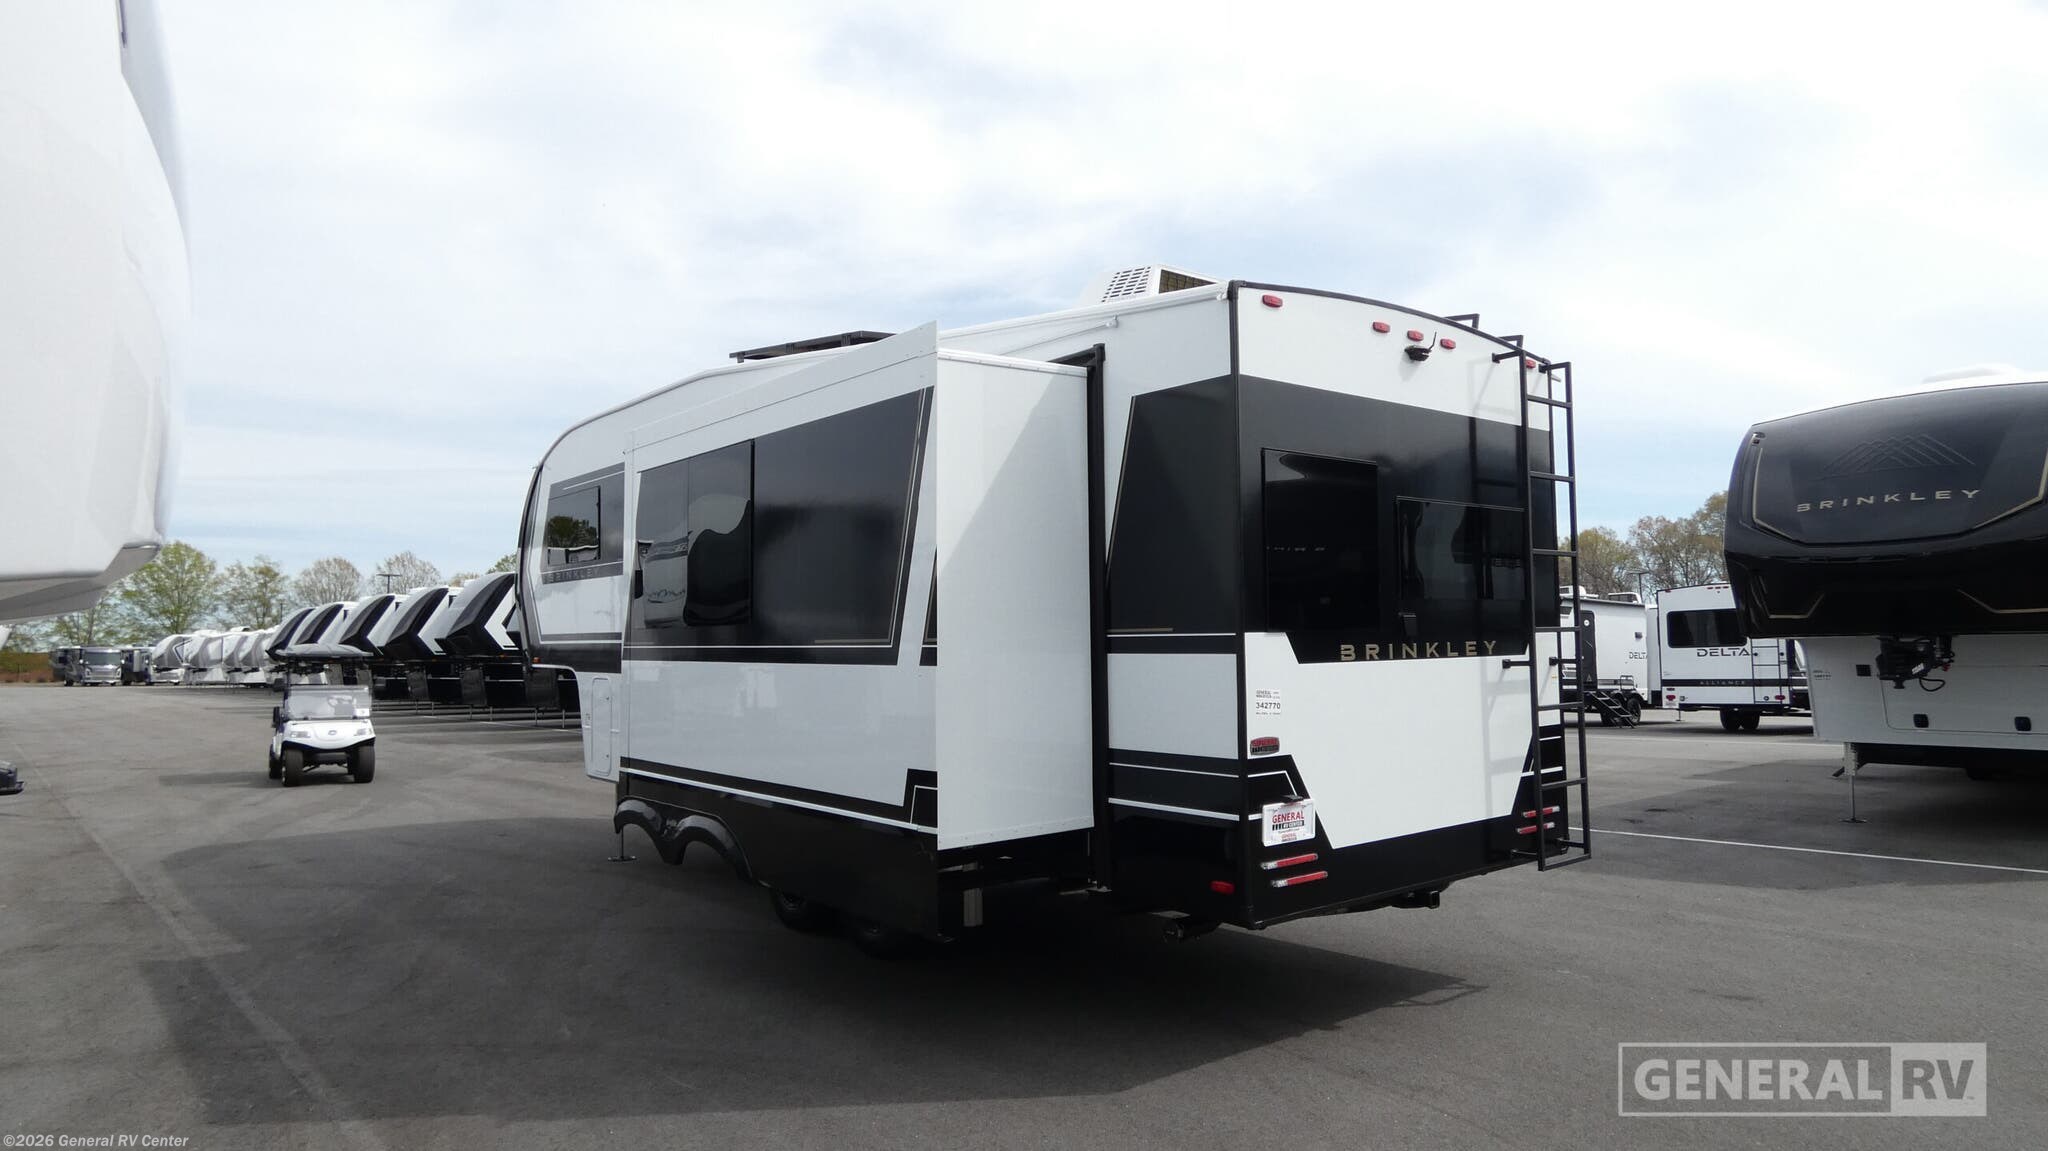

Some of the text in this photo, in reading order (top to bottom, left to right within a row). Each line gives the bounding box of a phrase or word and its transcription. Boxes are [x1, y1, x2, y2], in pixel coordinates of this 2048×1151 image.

[1797, 489, 1980, 512] BRINKLEY
[1340, 640, 1497, 661] BRINKLEY
[1696, 647, 1751, 657] DELTA
[1255, 702, 1281, 710] 342770
[1272, 810, 1304, 824] GENERAL
